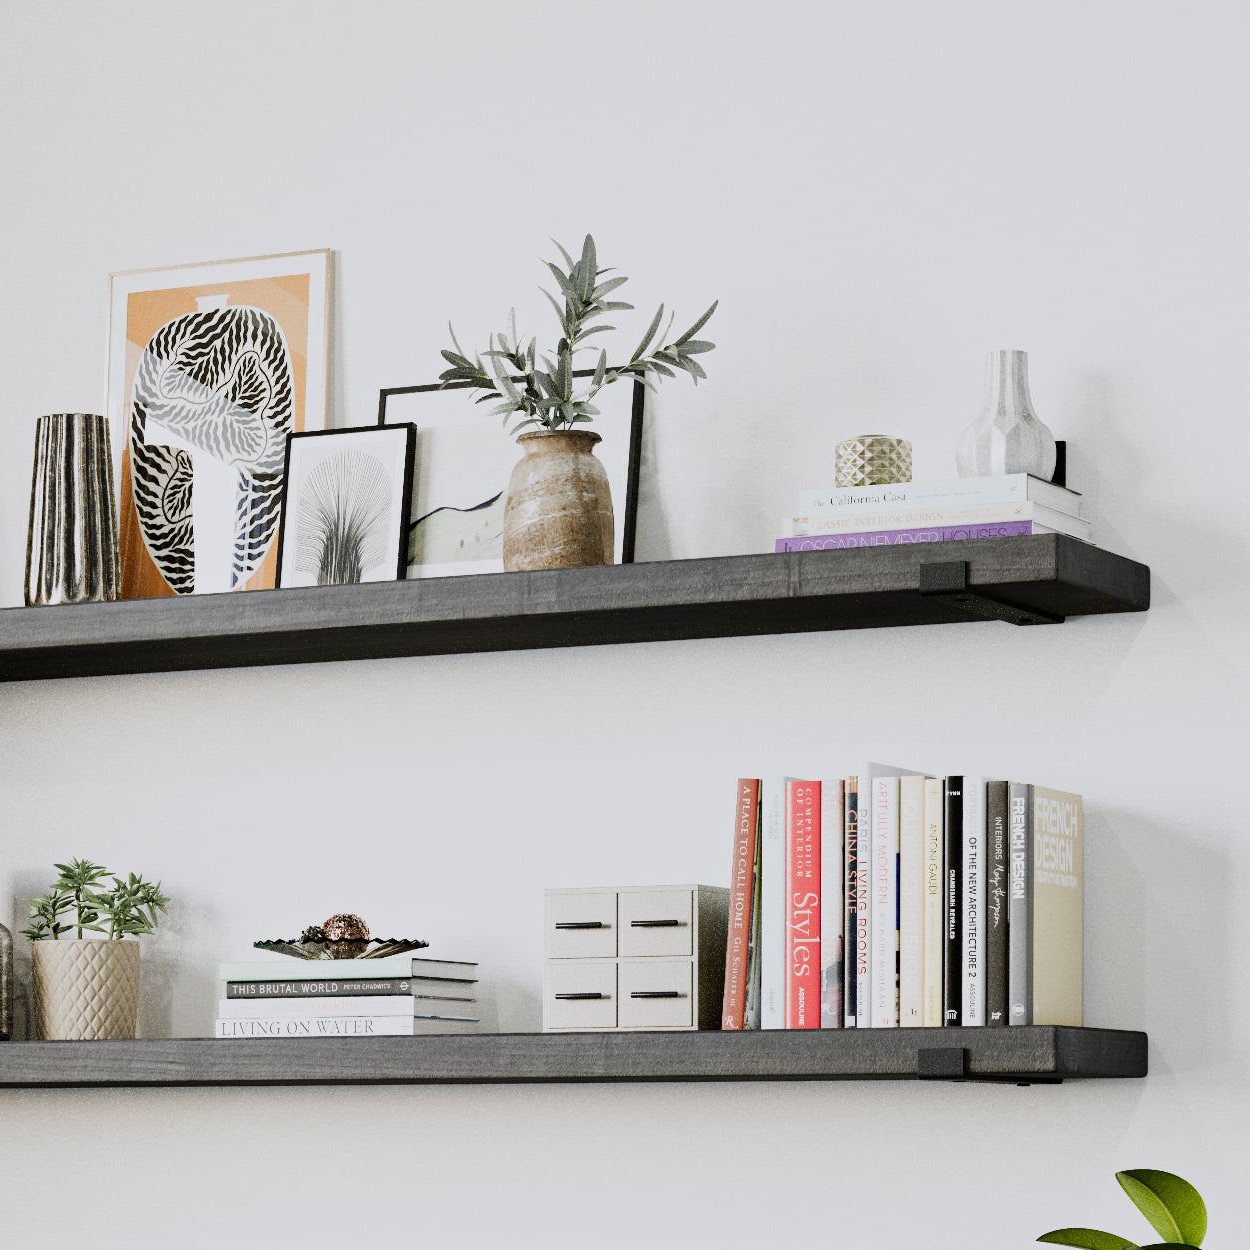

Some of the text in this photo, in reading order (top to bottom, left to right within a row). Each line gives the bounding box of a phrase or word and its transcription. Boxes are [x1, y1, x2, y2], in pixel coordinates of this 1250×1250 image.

[829, 494, 880, 506] California
[882, 491, 908, 502] Casa
[854, 514, 903, 528] INTERIOR
[905, 511, 945, 523] DESIGN
[742, 786, 751, 794] A
[740, 798, 751, 835] PLACE
[796, 788, 804, 878] OF INTERIOR
[804, 787, 812, 878] COMPENDIUM
[1035, 796, 1078, 838] FRENCH
[739, 838, 749, 856] TO
[877, 781, 889, 905] ARTFULLY MODERN
[928, 823, 938, 861] ANTONI
[968, 837, 978, 850] OF
[994, 816, 1003, 860] INTERIORS
[1012, 797, 1025, 899] FRENCH DESIGN
[1035, 833, 1074, 872] DESIGN
[736, 858, 747, 889] CALL
[847, 809, 858, 914] CHINA STYLE
[968, 852, 978, 870] THE
[857, 808, 868, 975] PARIS LIVING ROOMS
[903, 792, 919, 996] HOLLYWOOD INTERIORS
[968, 872, 978, 896] NEW
[734, 892, 745, 929] HOME
[733, 937, 742, 953] GIL
[789, 892, 821, 977] Styles
[968, 897, 977, 969] ARCHITECTURE
[232, 982, 338, 995] THIS BRUTAL WORLD
[731, 956, 741, 994] SCHAFER
[221, 1019, 374, 1036] LIVING ON WATER
